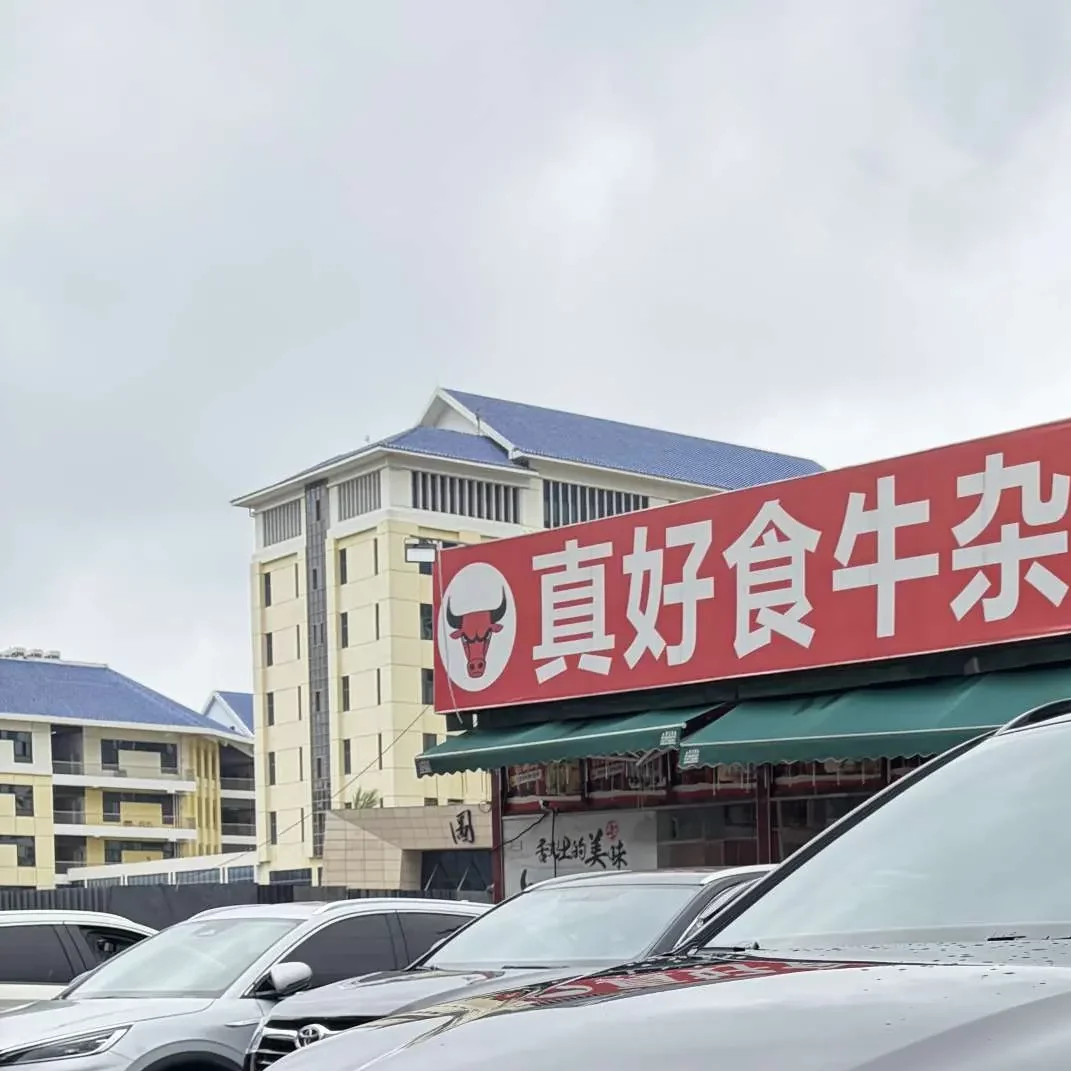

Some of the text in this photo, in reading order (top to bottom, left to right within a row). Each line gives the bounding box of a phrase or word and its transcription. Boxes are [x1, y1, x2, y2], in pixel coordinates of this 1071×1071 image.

[533, 452, 1070, 683] 真好食牛杂
